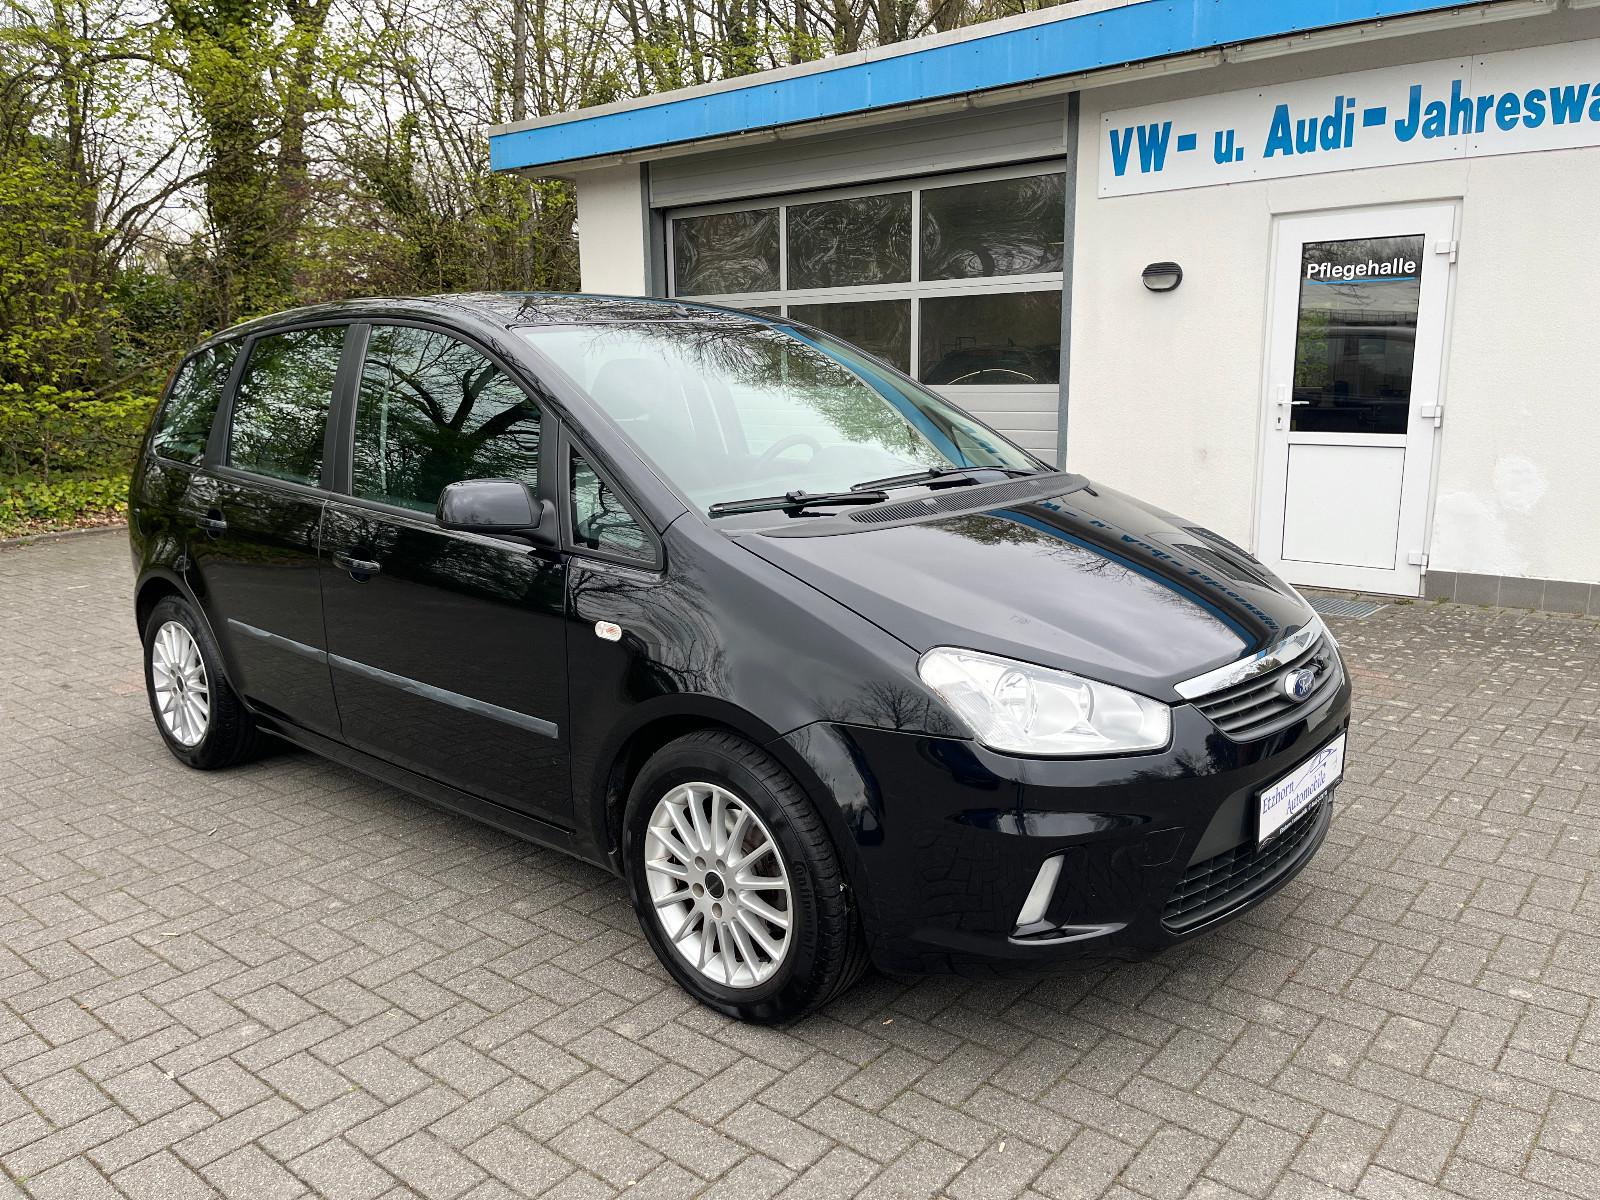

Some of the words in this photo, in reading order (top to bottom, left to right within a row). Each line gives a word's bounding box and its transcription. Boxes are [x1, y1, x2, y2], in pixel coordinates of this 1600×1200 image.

[1109, 121, 1197, 177] VW-
[1213, 129, 1245, 165] u.
[1306, 257, 1417, 280] Pflegehalle
[1262, 780, 1295, 816] Etzhorn
[1286, 769, 1327, 816] Automobile
